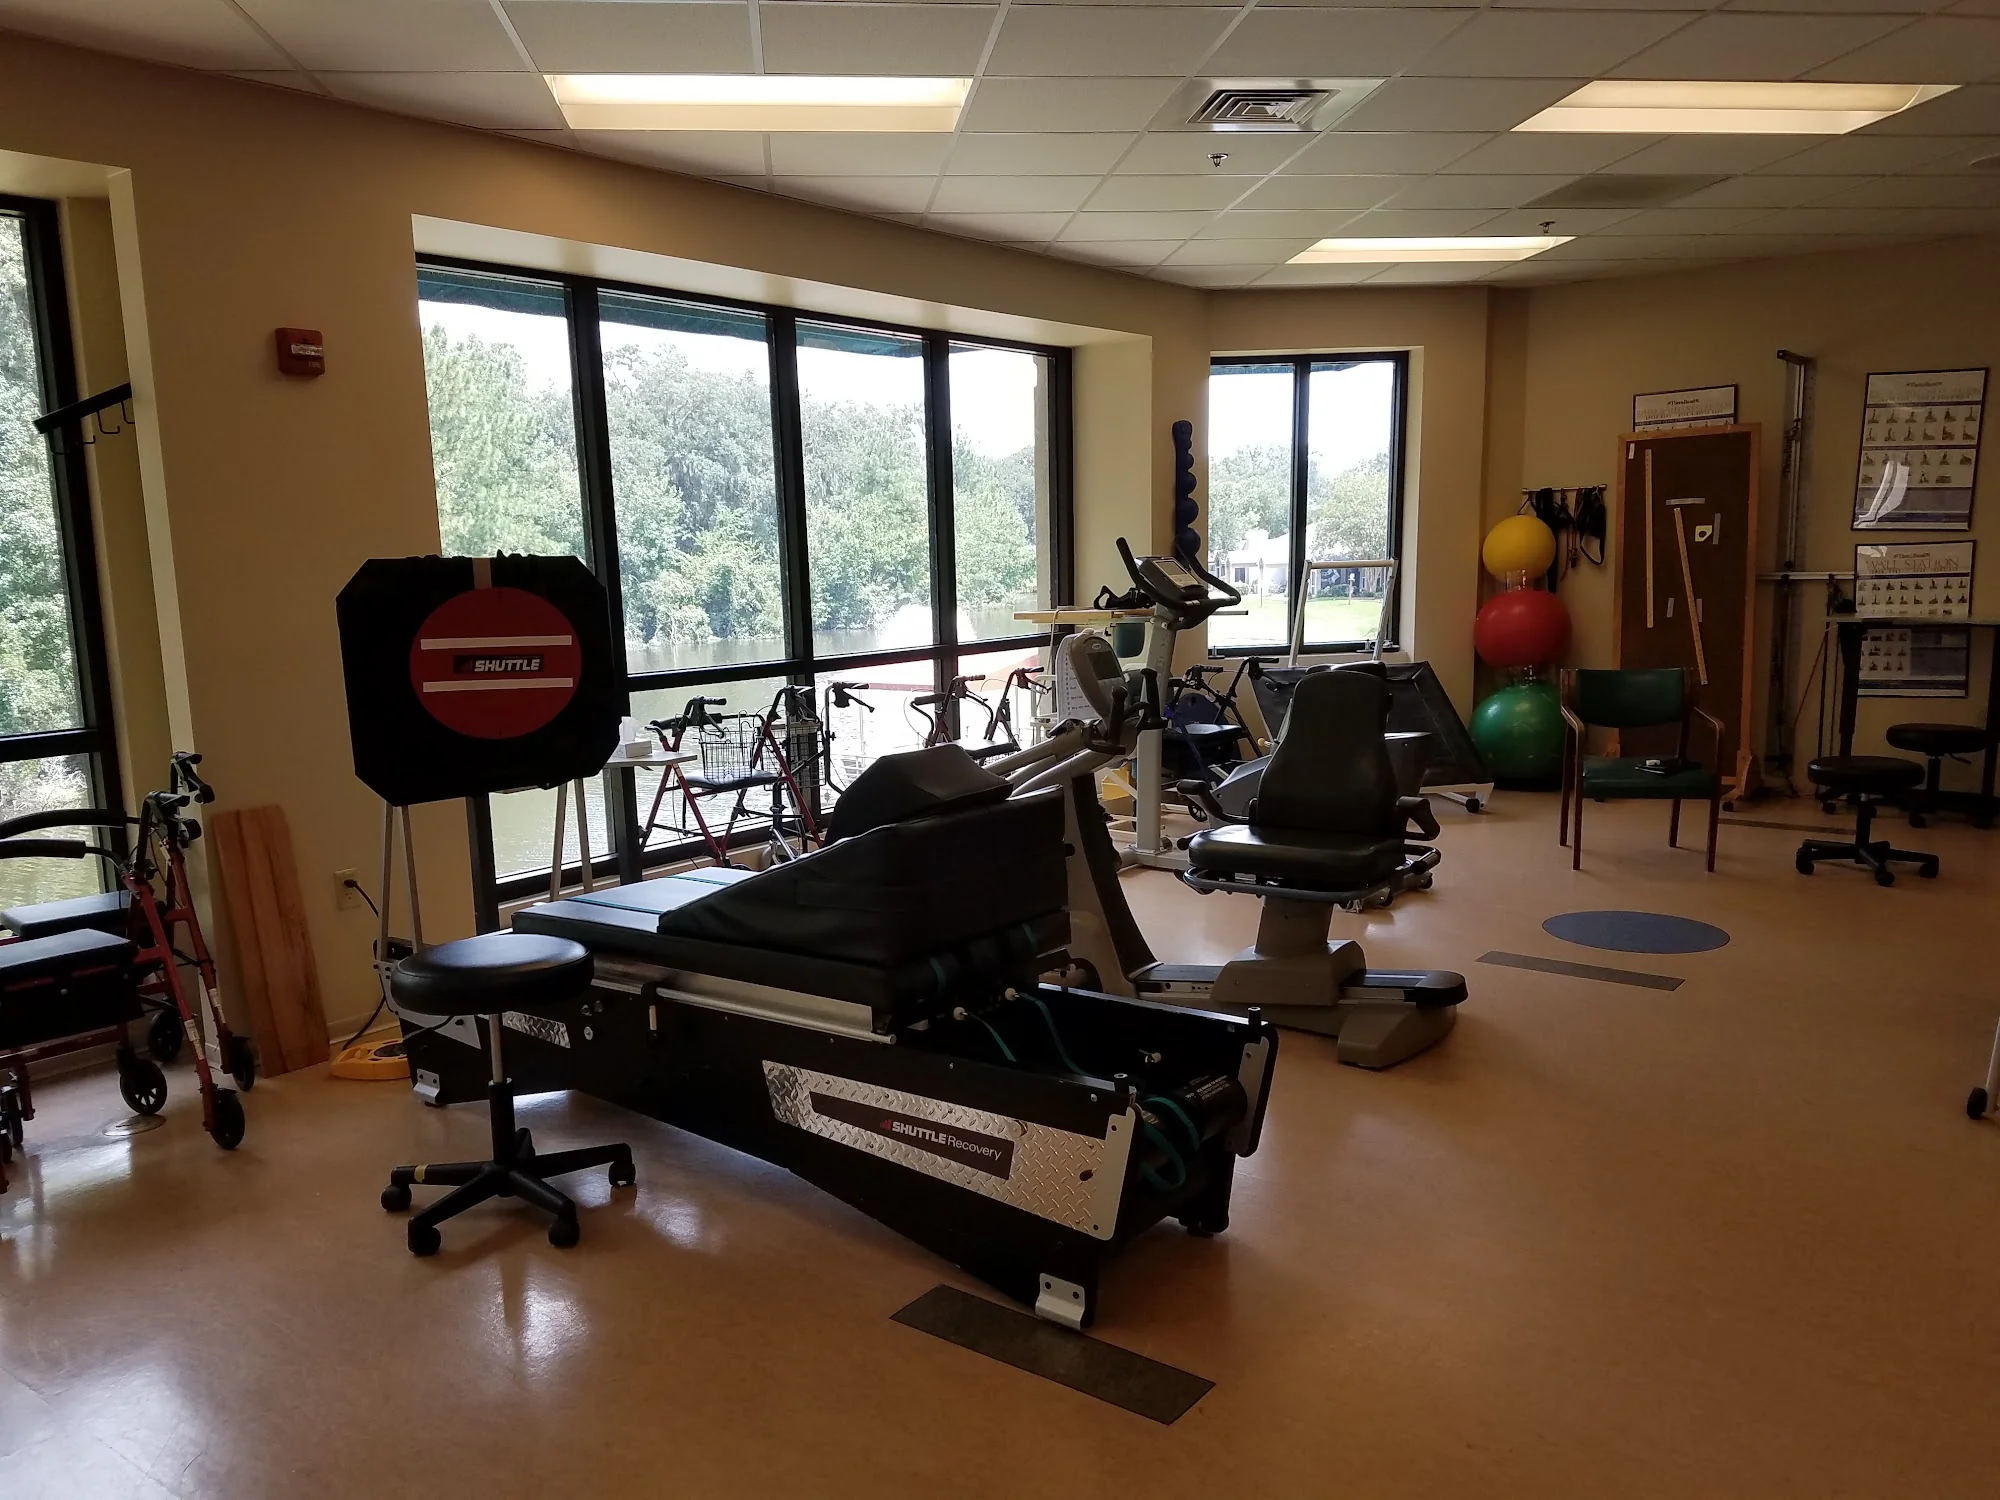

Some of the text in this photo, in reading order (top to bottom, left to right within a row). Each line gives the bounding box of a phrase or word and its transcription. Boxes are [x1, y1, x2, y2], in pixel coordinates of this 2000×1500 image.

[473, 658, 541, 672] SHUTTLE
[891, 1120, 1002, 1161] SHUTTLE Recovery
